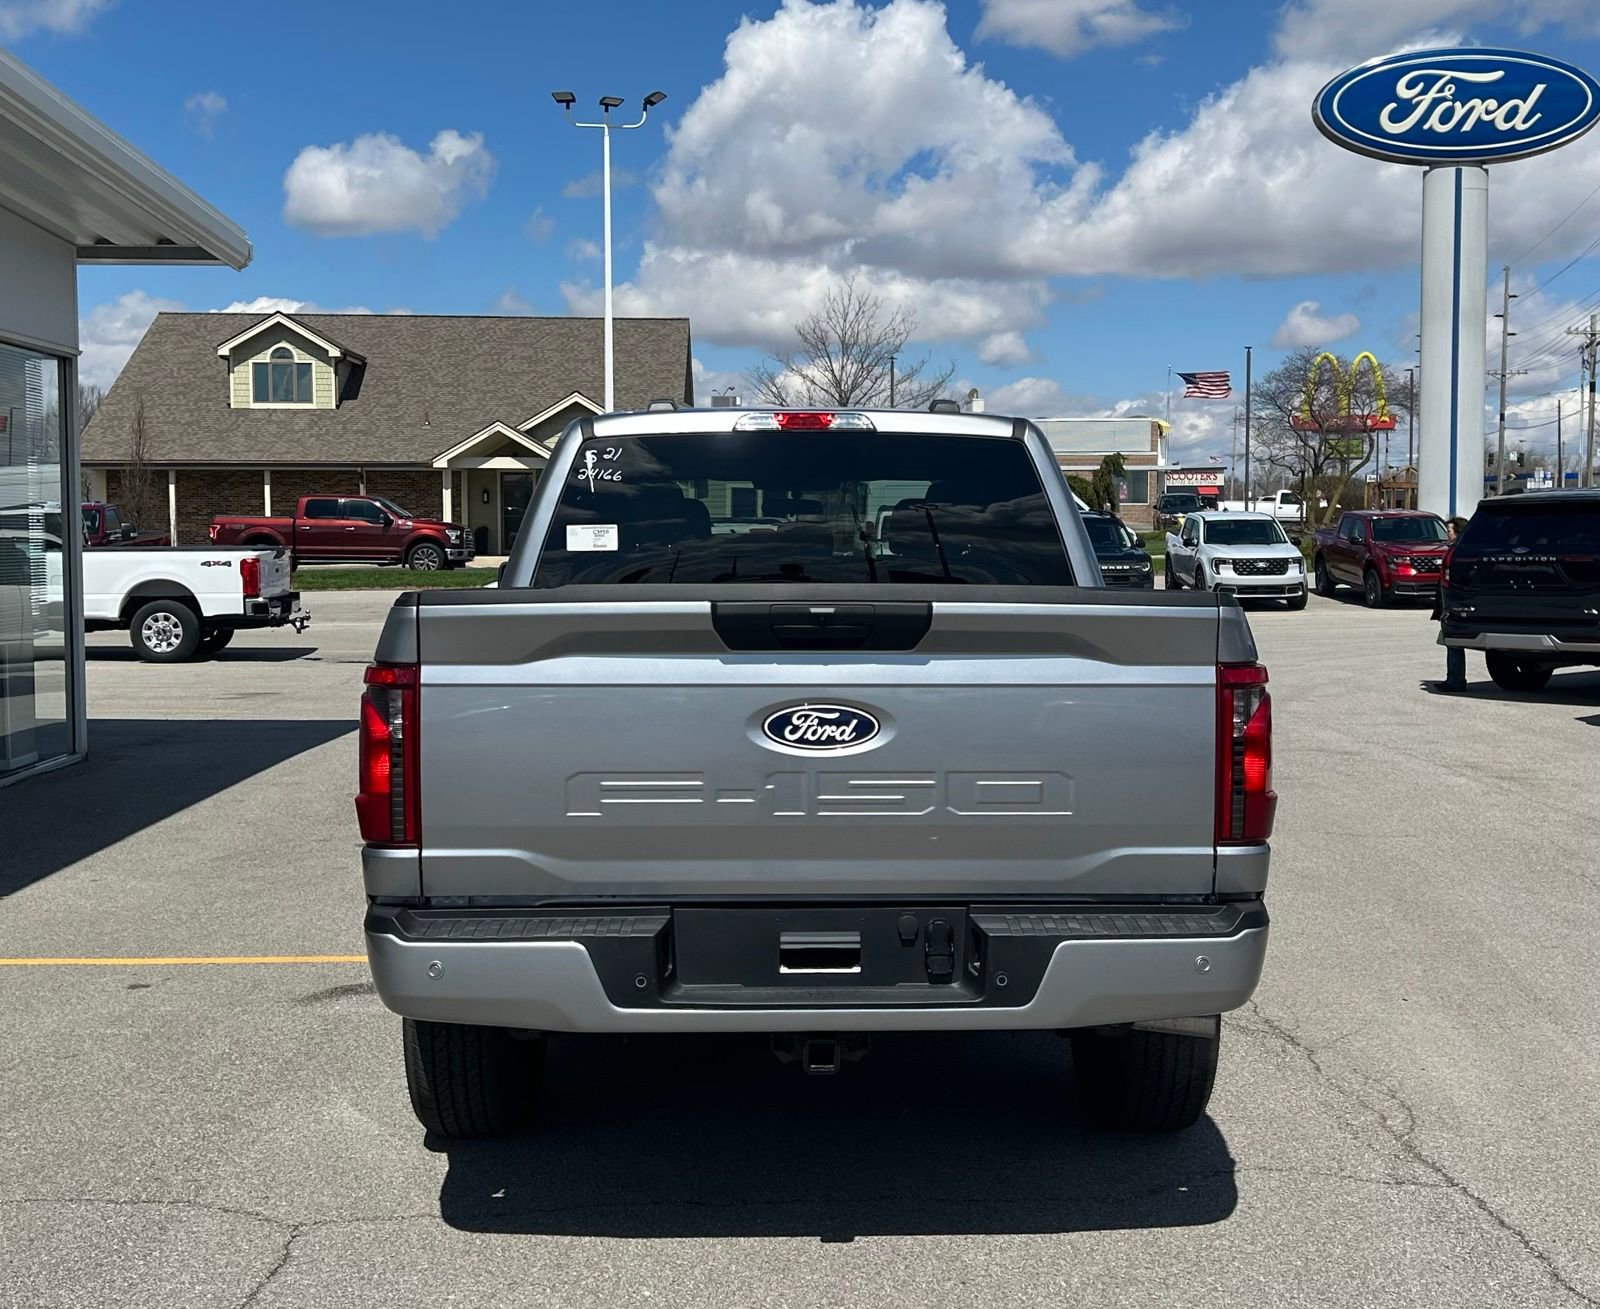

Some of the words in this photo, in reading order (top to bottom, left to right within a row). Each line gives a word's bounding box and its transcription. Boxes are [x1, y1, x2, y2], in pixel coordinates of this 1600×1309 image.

[1380, 69, 1547, 134] Ford
[603, 447, 623, 461] 21
[784, 710, 858, 741] Ford
[565, 770, 1075, 817] F-150
